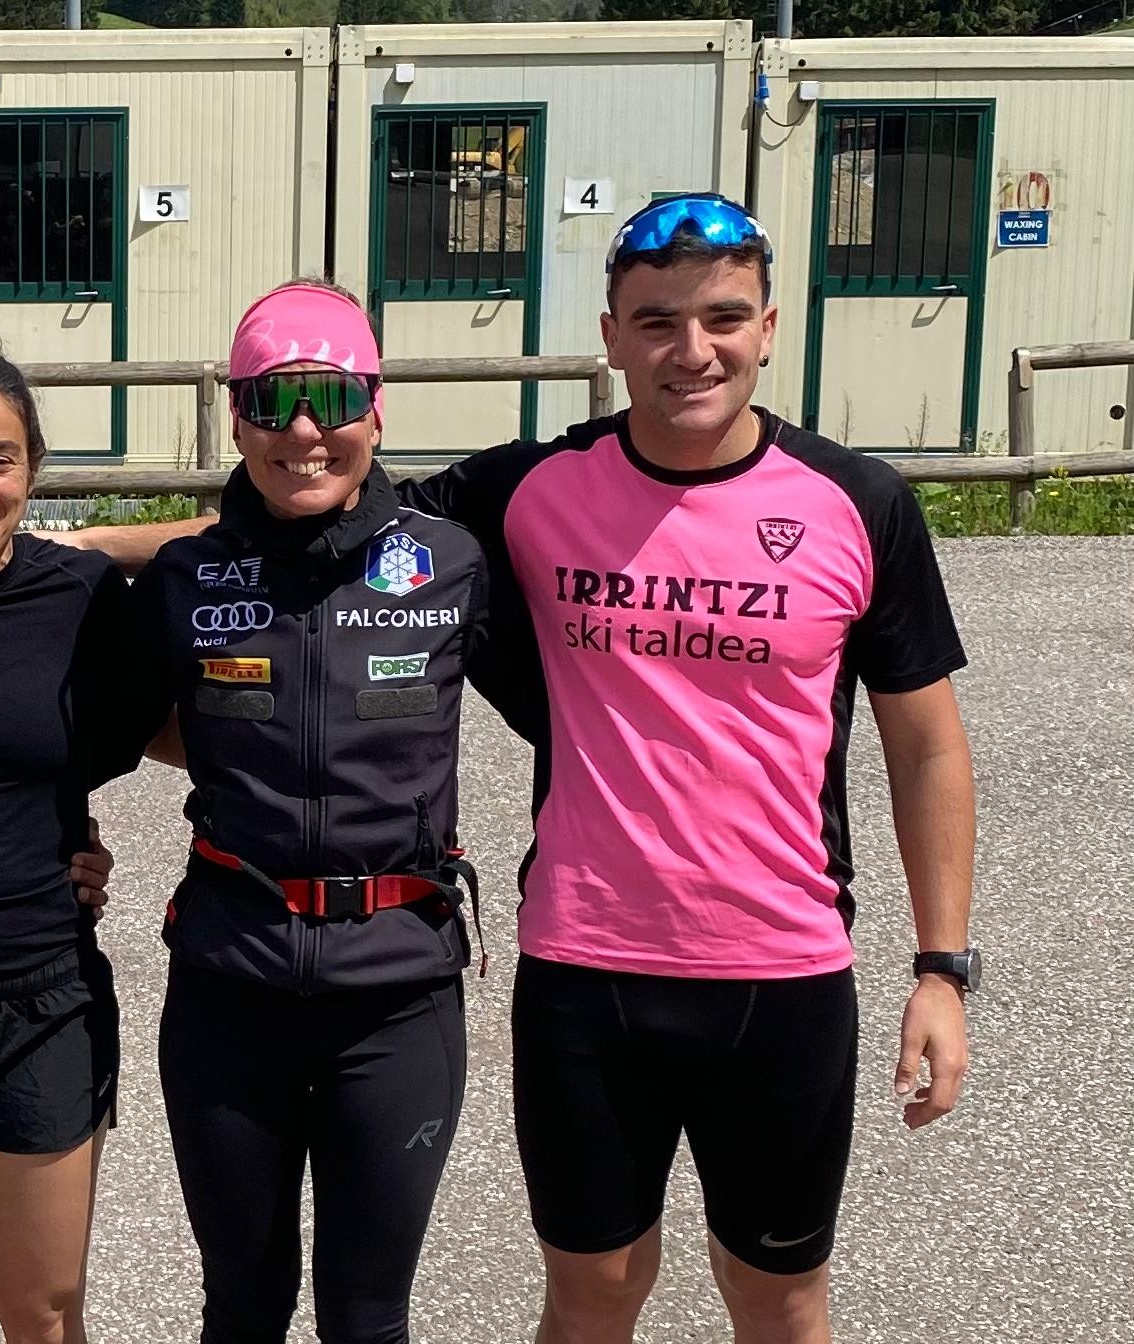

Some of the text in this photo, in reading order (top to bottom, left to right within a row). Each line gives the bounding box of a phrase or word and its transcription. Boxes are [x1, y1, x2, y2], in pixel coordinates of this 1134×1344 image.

[156, 192, 173, 217] 5
[580, 183, 599, 209] 4
[1004, 220, 1043, 229] WAXING
[1008, 233, 1038, 241] CABIN
[382, 537, 417, 554] FISI
[197, 557, 264, 586] EA7
[555, 566, 788, 620] IRRINTZI
[336, 607, 460, 628] FALCONERI
[193, 636, 227, 648] Audi
[565, 612, 771, 664] ski taldea
[207, 661, 263, 678] PIRELLI
